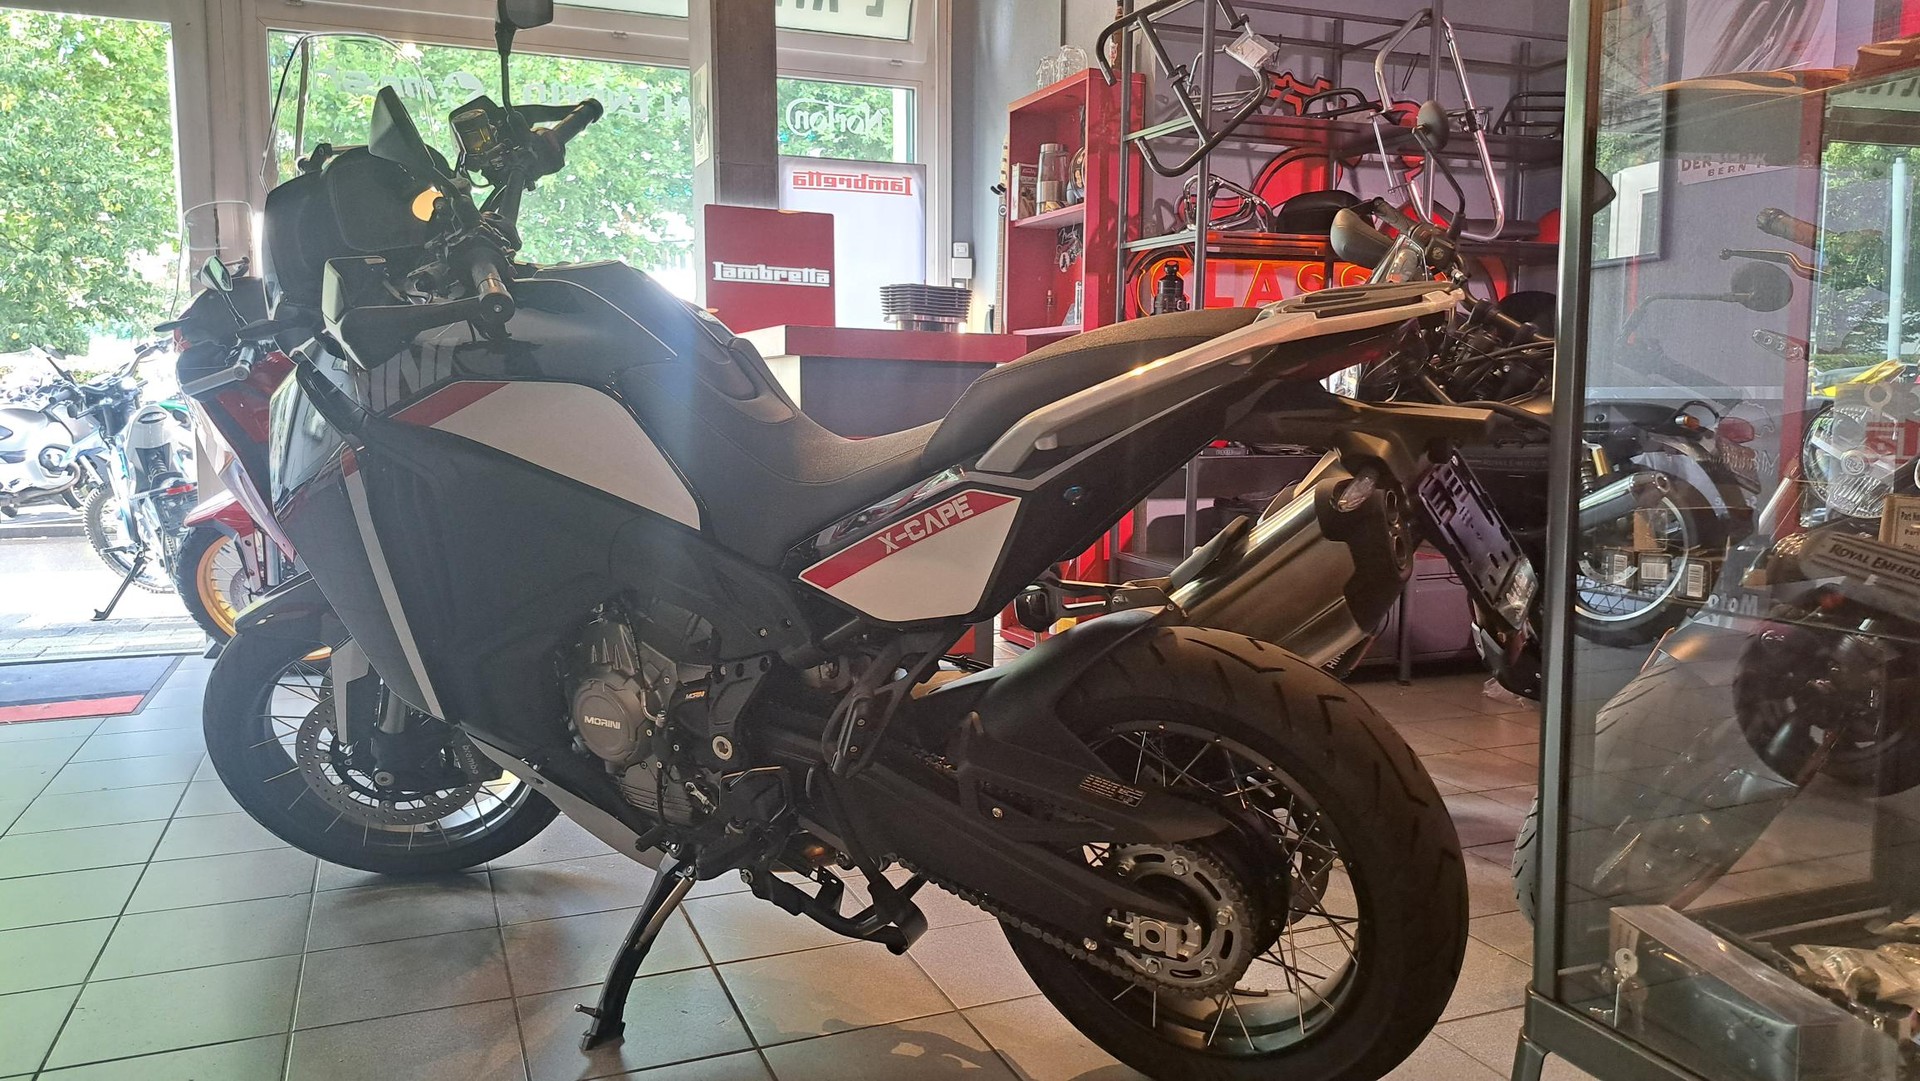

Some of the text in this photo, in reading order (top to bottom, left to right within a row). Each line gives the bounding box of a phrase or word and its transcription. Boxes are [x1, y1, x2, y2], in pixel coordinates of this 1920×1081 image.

[712, 261, 830, 287] Lambretta
[878, 494, 974, 554] X-CAPE
[1829, 544, 1920, 580] ROYAL ENFIEL
[584, 715, 621, 730] MORINI
